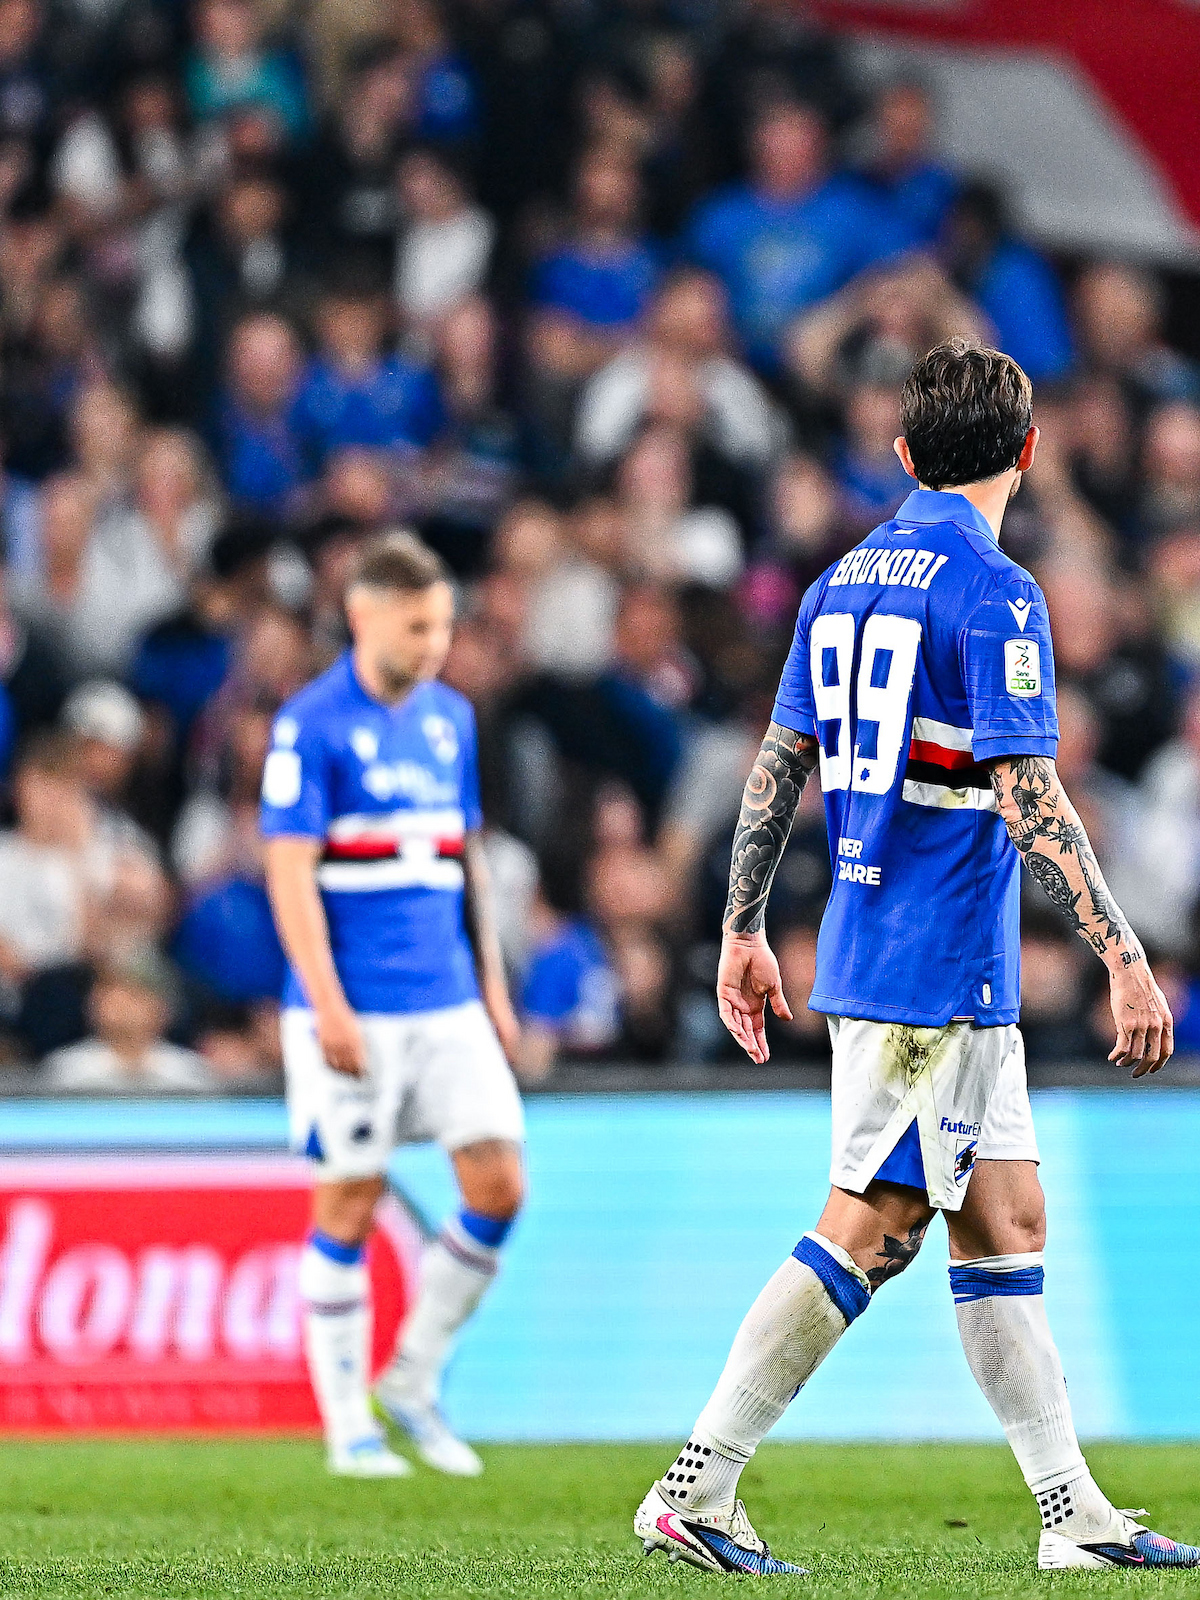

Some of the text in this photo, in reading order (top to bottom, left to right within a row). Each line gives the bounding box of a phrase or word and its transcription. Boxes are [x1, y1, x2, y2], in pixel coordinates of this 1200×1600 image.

[828, 548, 950, 590] BRUNORI
[810, 613, 923, 796] 99
[1010, 678, 1037, 690] BKT
